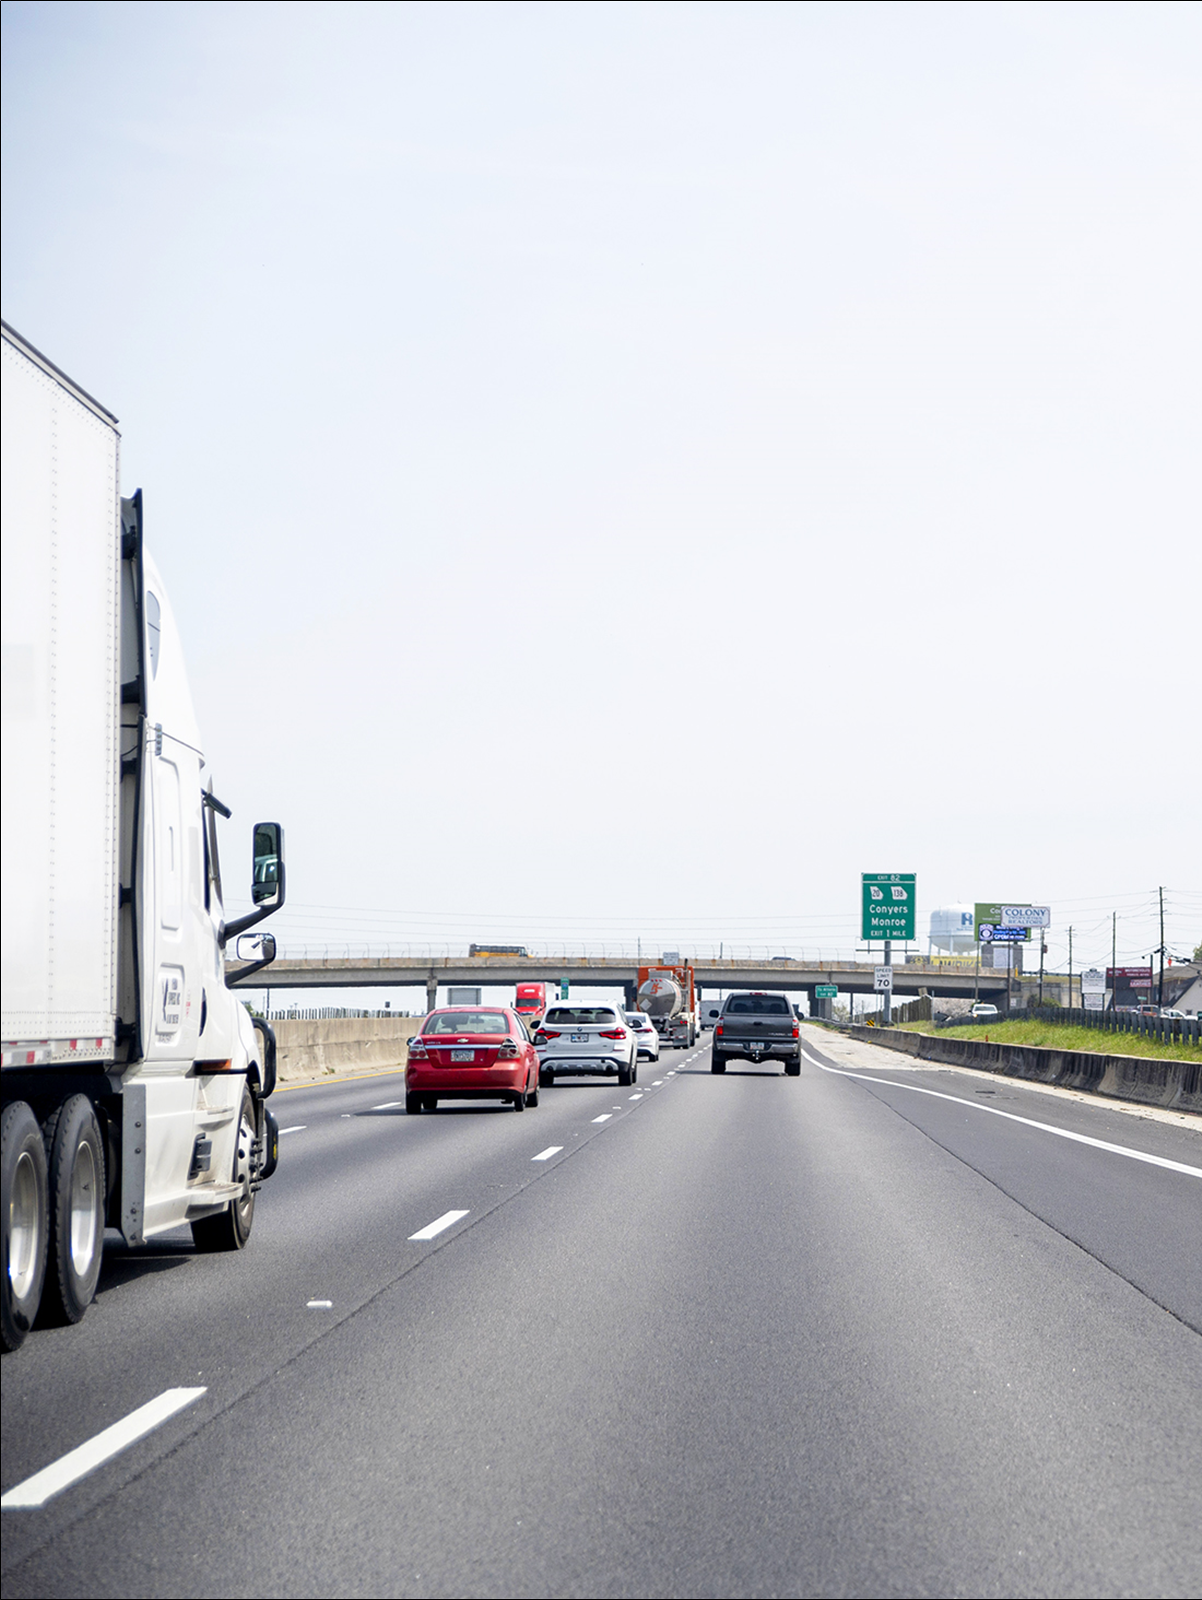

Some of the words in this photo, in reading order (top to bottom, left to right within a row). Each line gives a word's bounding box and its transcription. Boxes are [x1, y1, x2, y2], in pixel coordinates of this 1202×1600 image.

[890, 874, 901, 882] 82
[872, 889, 881, 898] 20
[869, 904, 909, 915] Conyers
[1005, 908, 1047, 917] COLONY
[871, 917, 906, 926] Monroe
[886, 929, 890, 938] 1
[876, 979, 890, 987] 70
